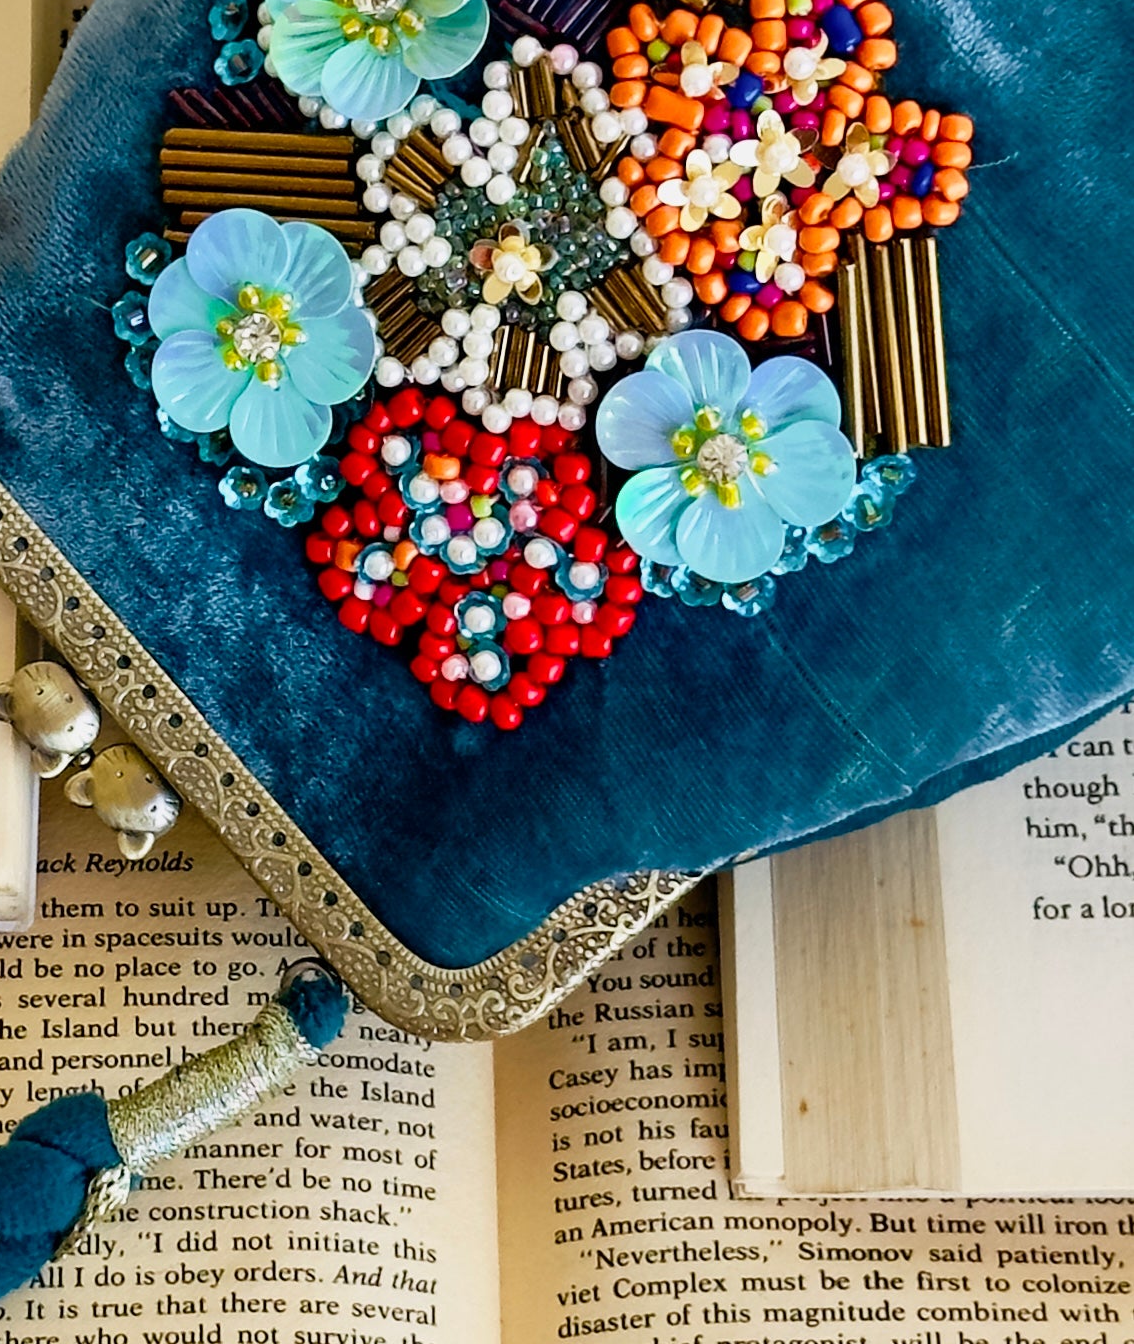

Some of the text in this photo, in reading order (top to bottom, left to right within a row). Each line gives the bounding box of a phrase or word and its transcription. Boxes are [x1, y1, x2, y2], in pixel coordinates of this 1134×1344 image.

[1022, 773, 1121, 806] though
[84, 849, 196, 879] Reynolds
[1032, 895, 1095, 921] for a
[554, 1210, 862, 1245] an American monopoly.
